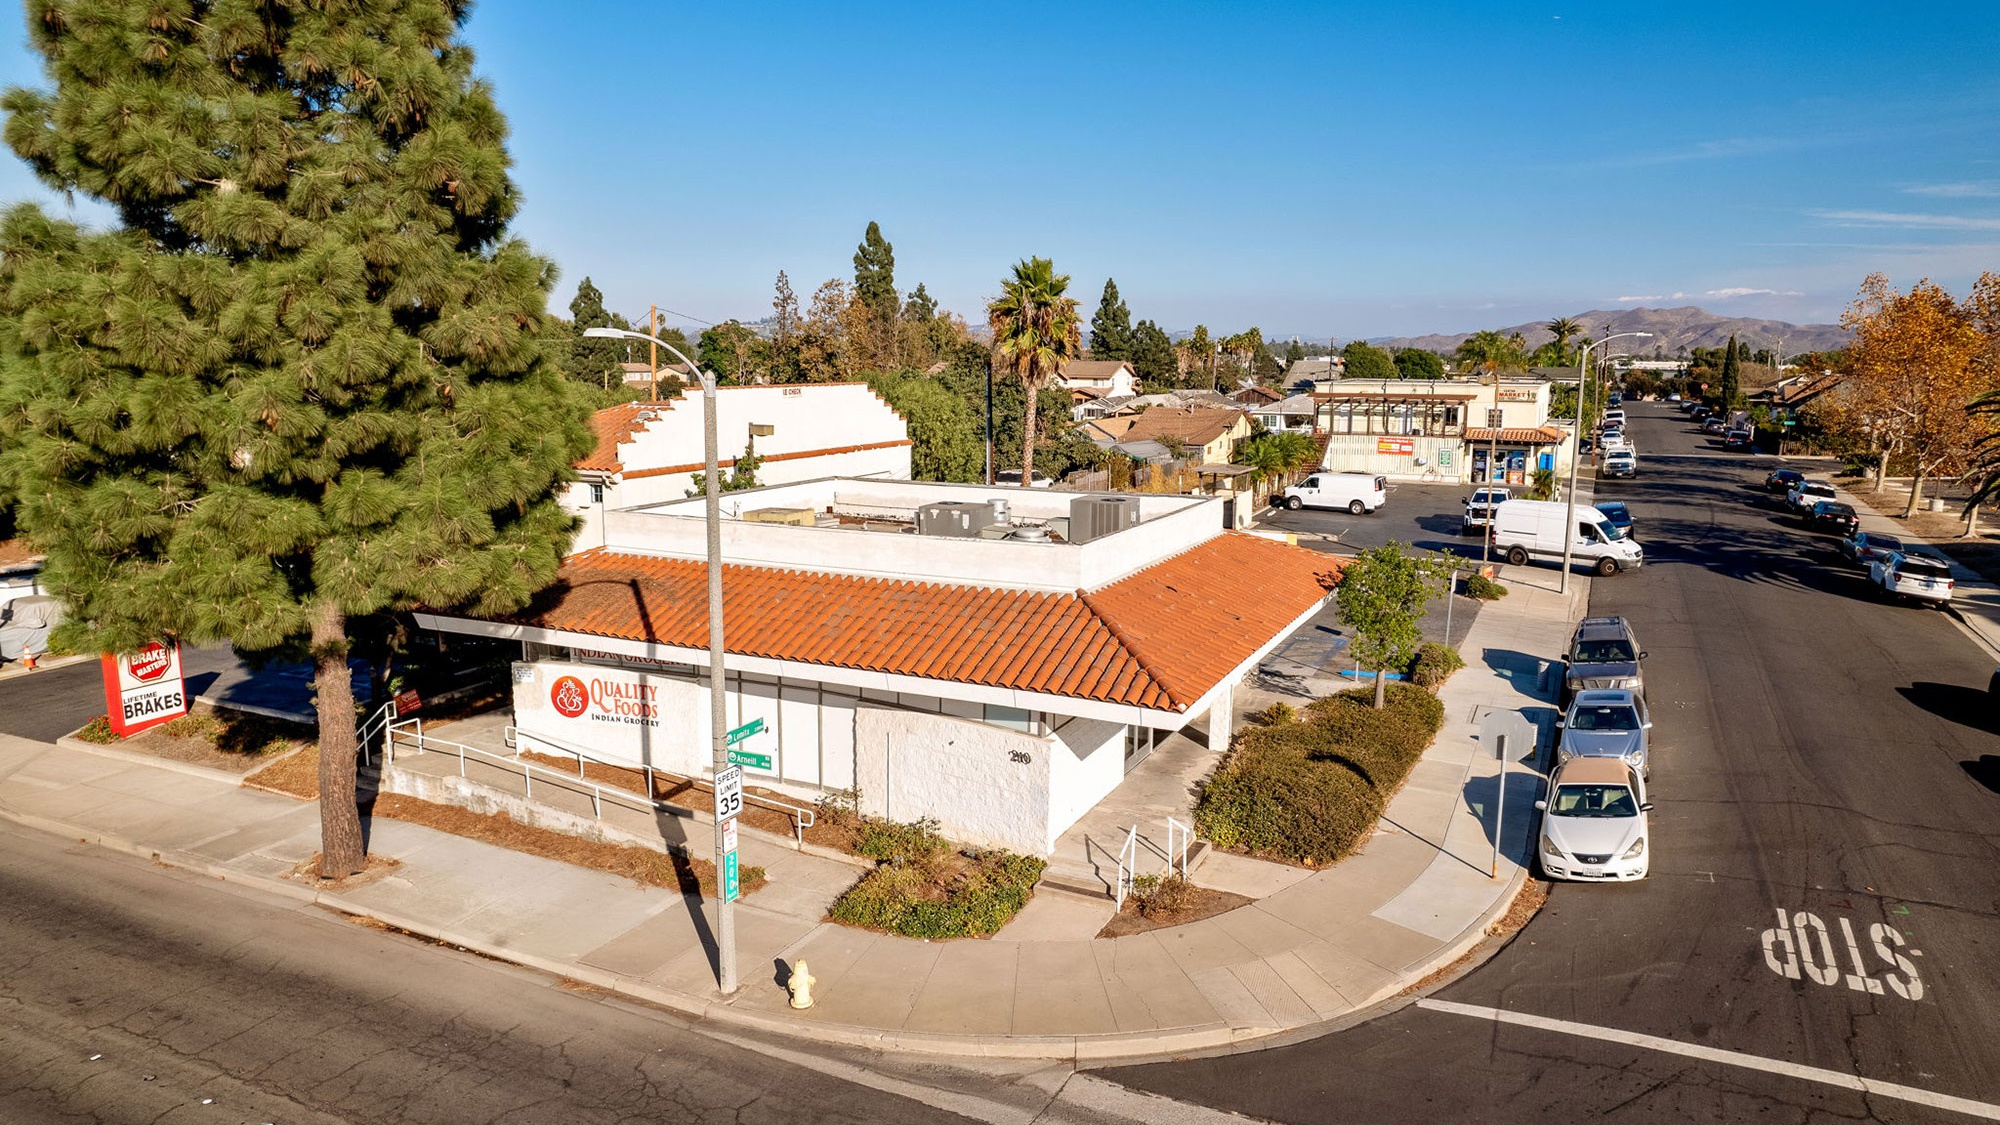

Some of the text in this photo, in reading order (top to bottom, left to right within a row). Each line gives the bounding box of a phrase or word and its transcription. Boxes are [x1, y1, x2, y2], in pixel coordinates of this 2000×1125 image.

[131, 648, 166, 666] BRAKE
[136, 659, 168, 677] MASTERS
[123, 691, 157, 705] LIFETIME
[590, 677, 658, 714] QUALITY
[123, 692, 183, 720] BRAKES
[614, 698, 658, 719] FOODS
[591, 713, 660, 727] INDIAN GROCERY
[737, 754, 757, 766] Arneill
[717, 769, 740, 785] SPEED
[720, 781, 737, 795] LIMIT
[720, 792, 740, 816] 35
[1761, 908, 1923, 1001] STOP
